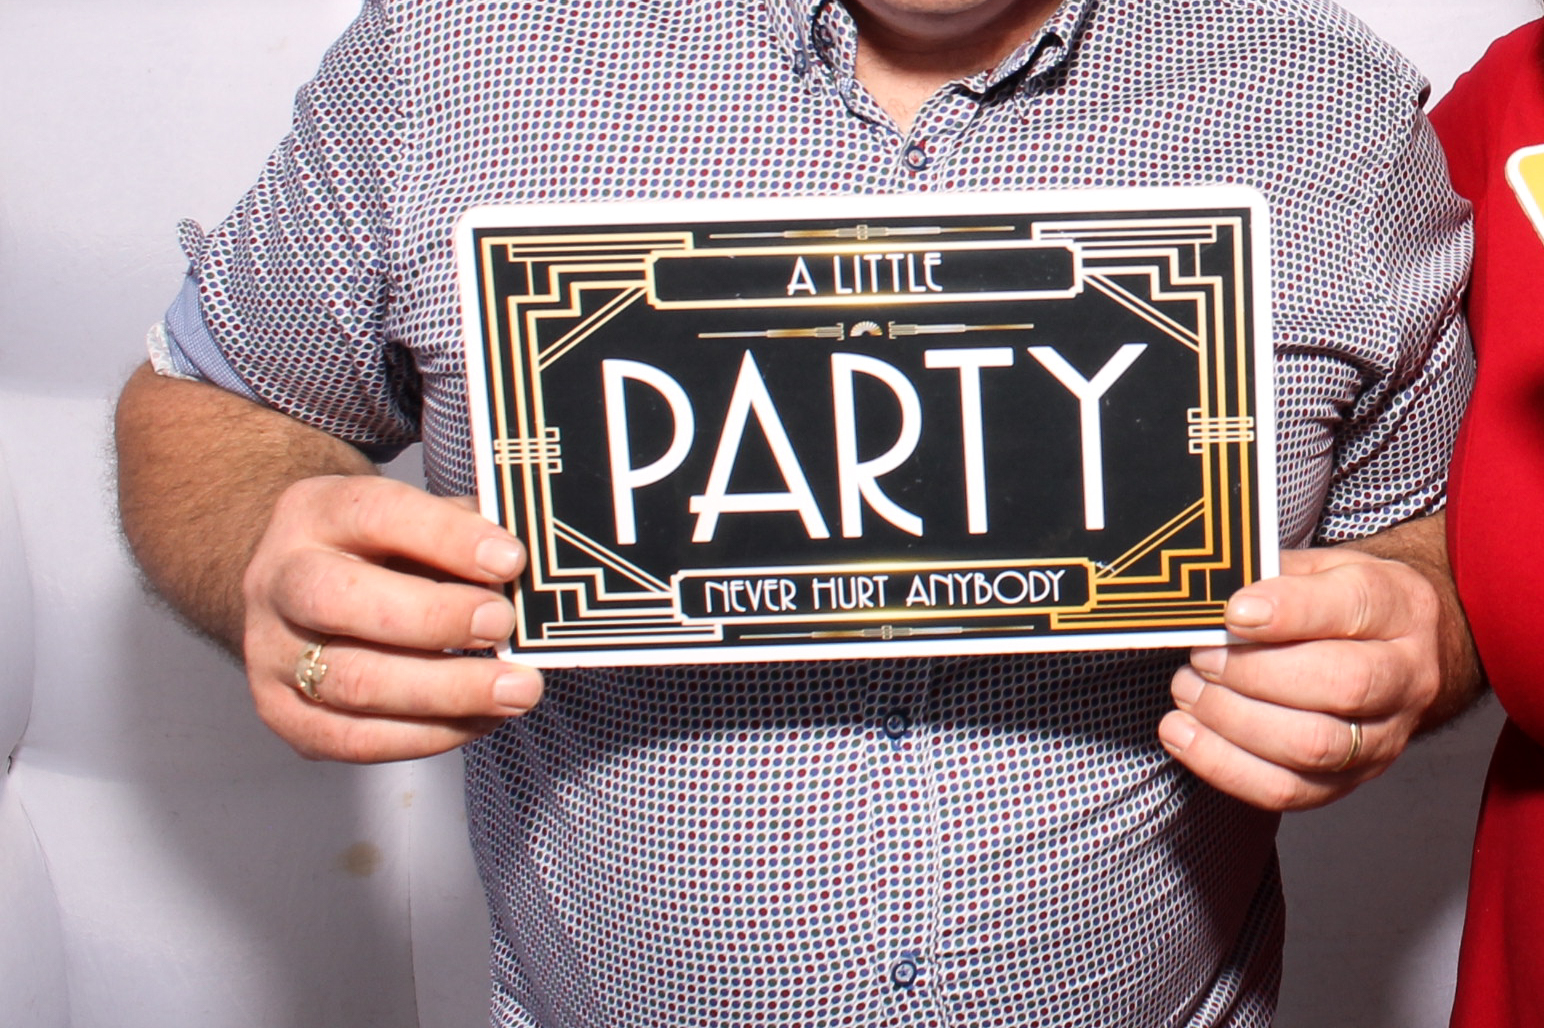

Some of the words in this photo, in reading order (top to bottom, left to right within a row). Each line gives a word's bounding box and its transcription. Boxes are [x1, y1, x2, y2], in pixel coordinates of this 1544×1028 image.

[787, 256, 817, 296] A
[833, 252, 943, 294] LITTLE
[602, 342, 1148, 546] PARTY
[705, 578, 797, 613] NEVER
[812, 575, 889, 609] HURT
[906, 570, 1066, 607] ANYBODY
